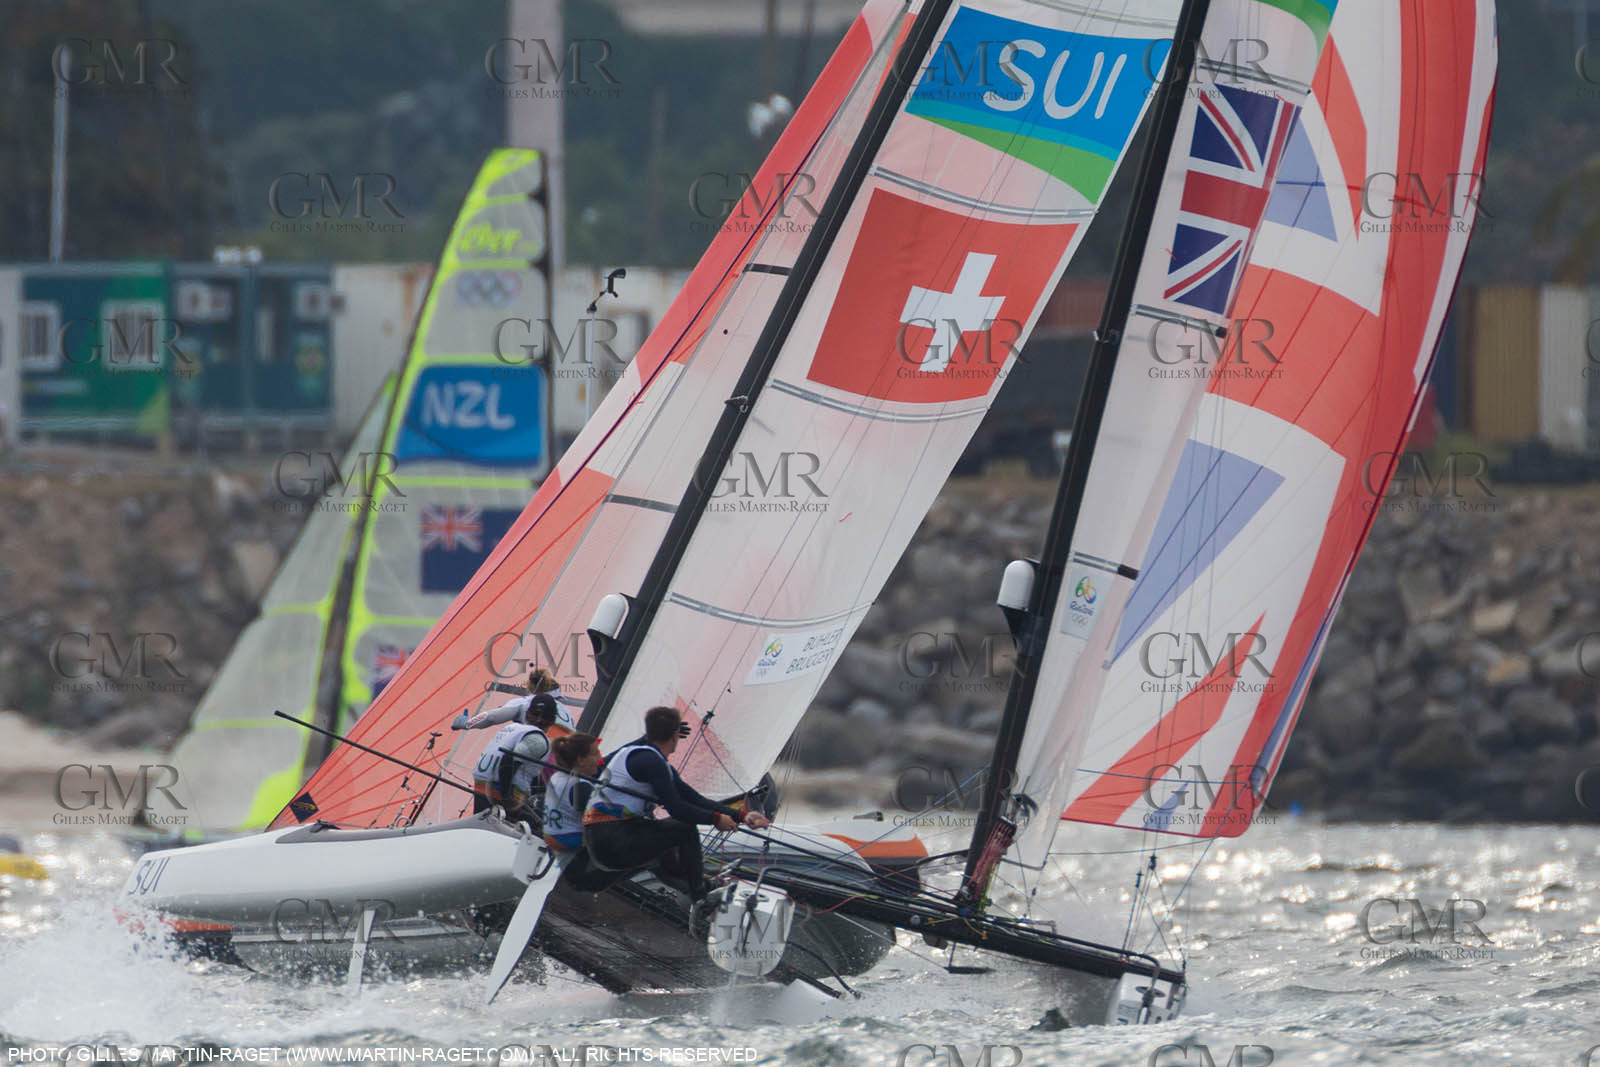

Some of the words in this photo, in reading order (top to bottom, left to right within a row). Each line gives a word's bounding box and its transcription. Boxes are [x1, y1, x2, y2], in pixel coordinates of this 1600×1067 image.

[983, 39, 1127, 120] SUI
[421, 380, 515, 430] NZL
[128, 856, 170, 895] SUI
